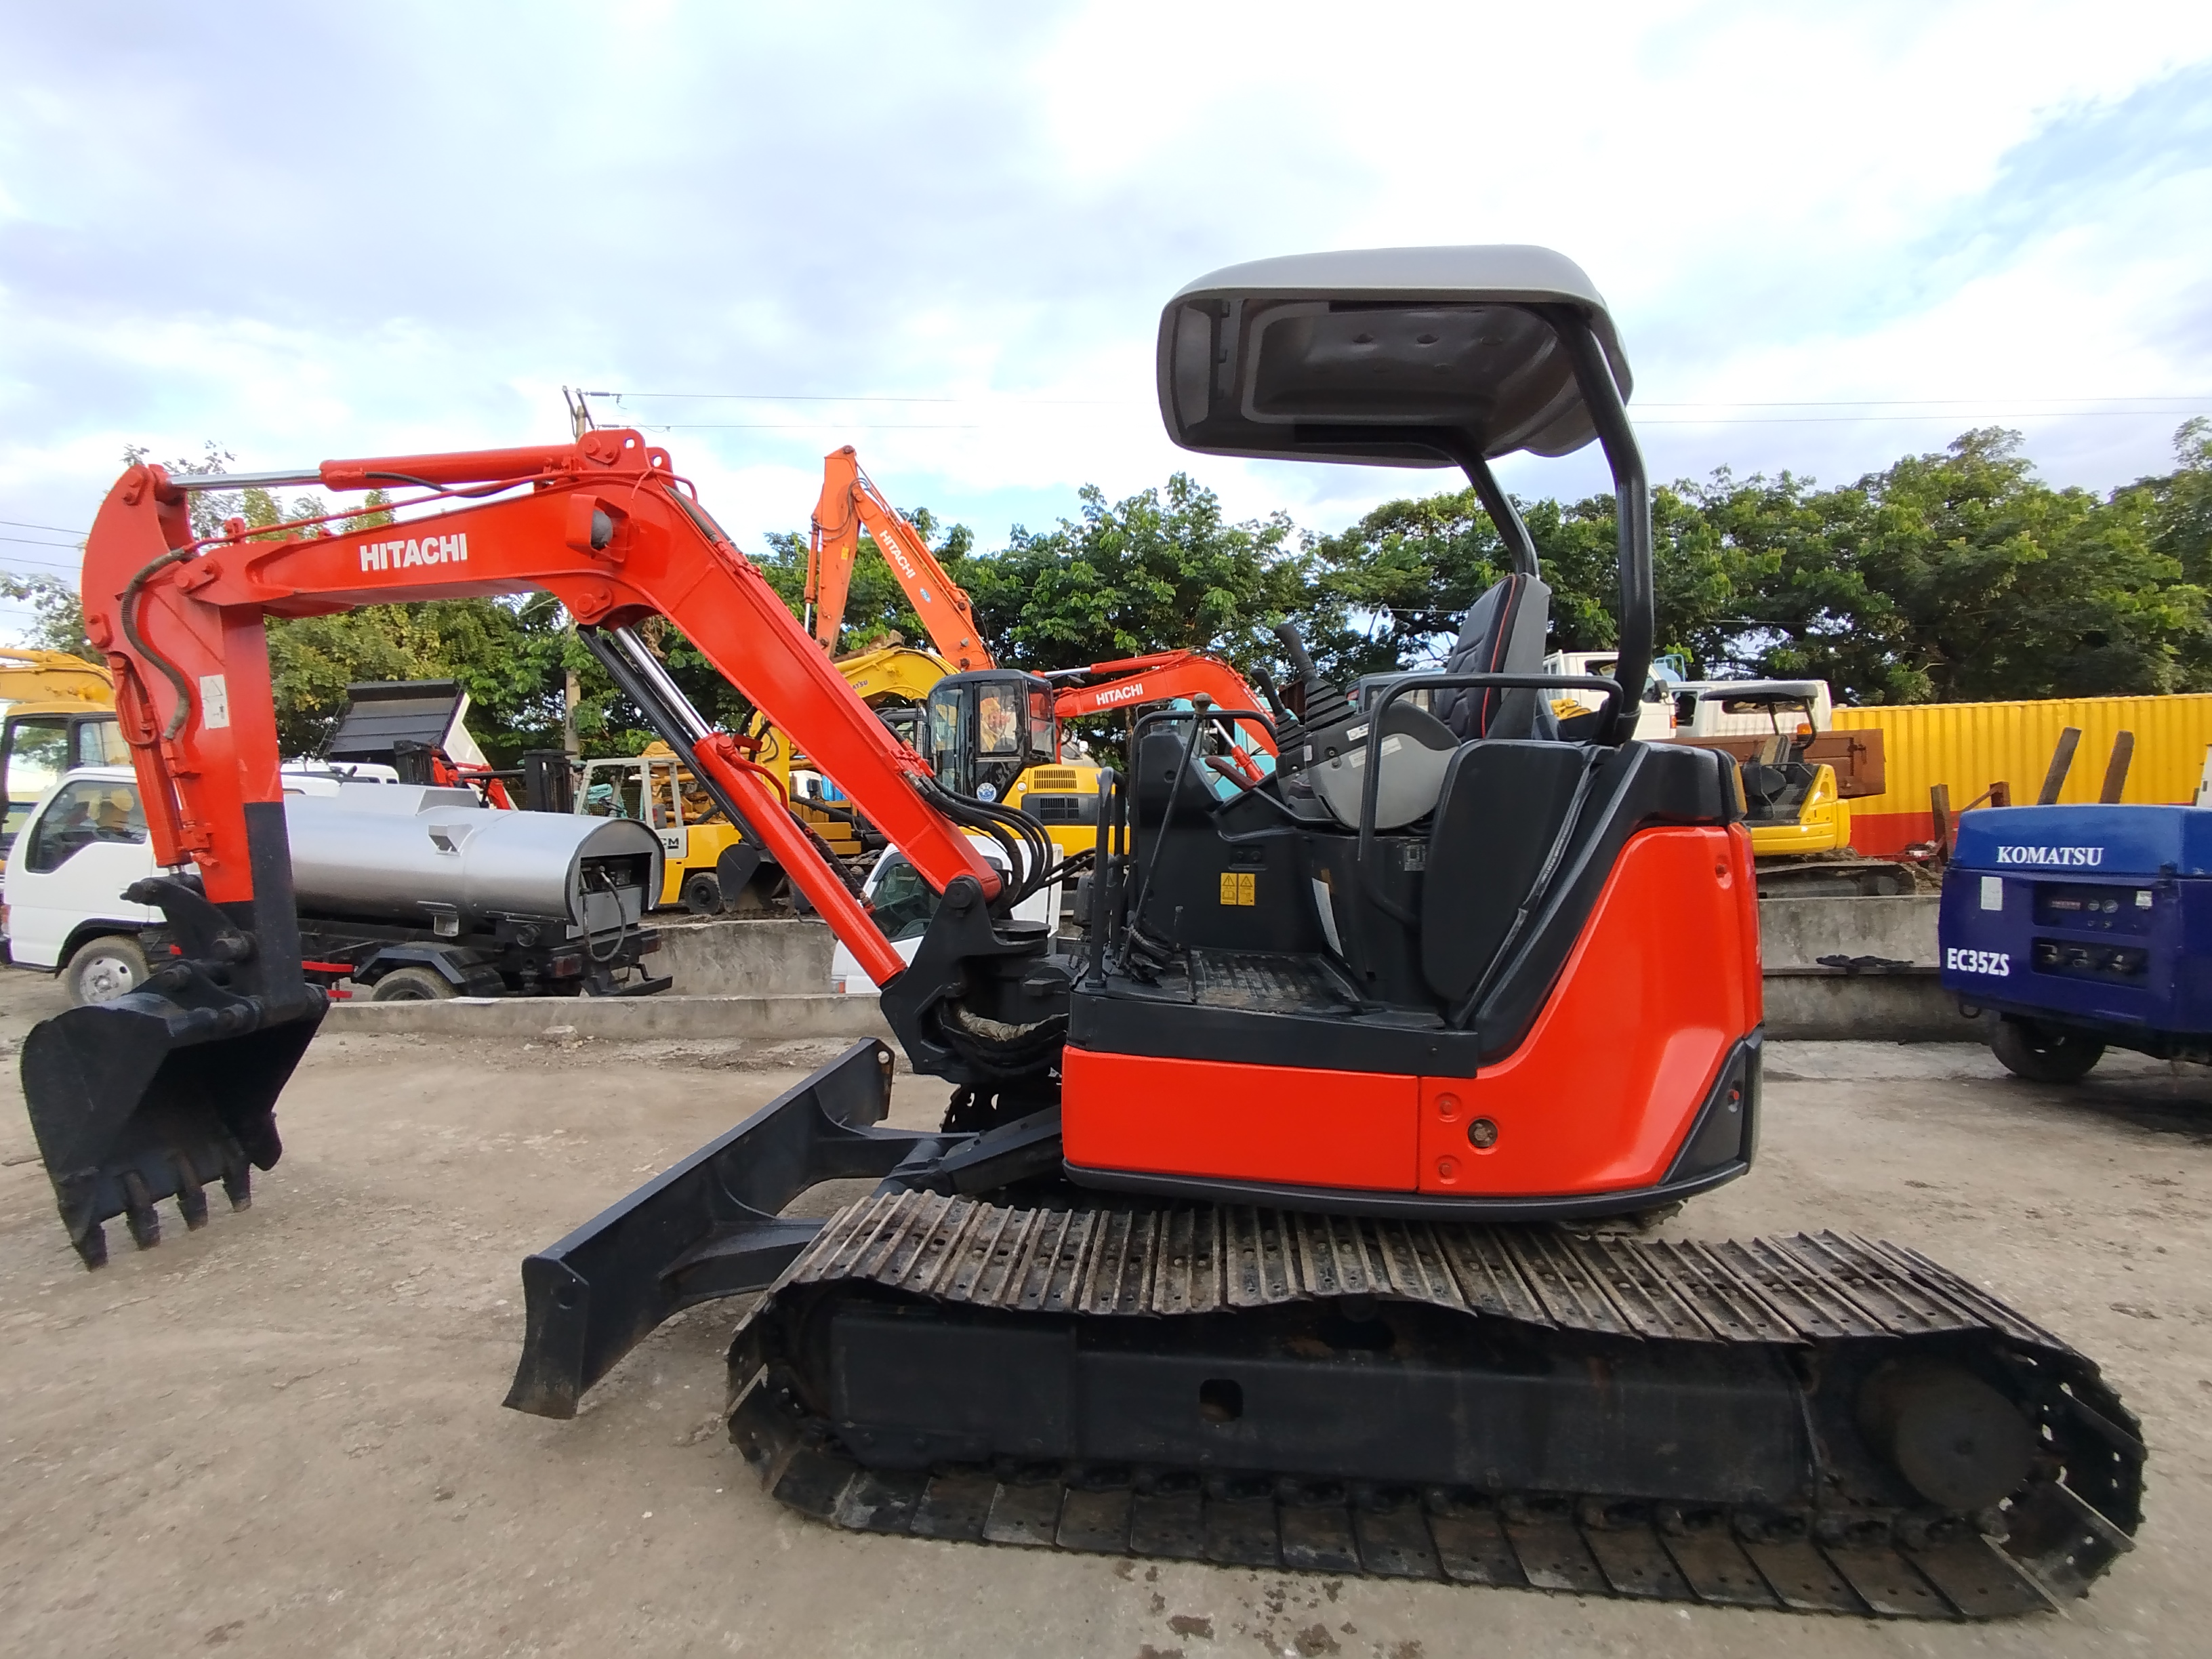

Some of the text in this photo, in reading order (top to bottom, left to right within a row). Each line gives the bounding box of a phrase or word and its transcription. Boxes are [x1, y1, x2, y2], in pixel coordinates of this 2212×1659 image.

[360, 533, 468, 571] HITACHI
[879, 529, 916, 579] HITACHI
[852, 680, 868, 689] ATSU
[1096, 682, 1143, 705] HITACHI
[1996, 846, 2104, 866] KOMATSU
[1947, 947, 2009, 976] EC35ZS
